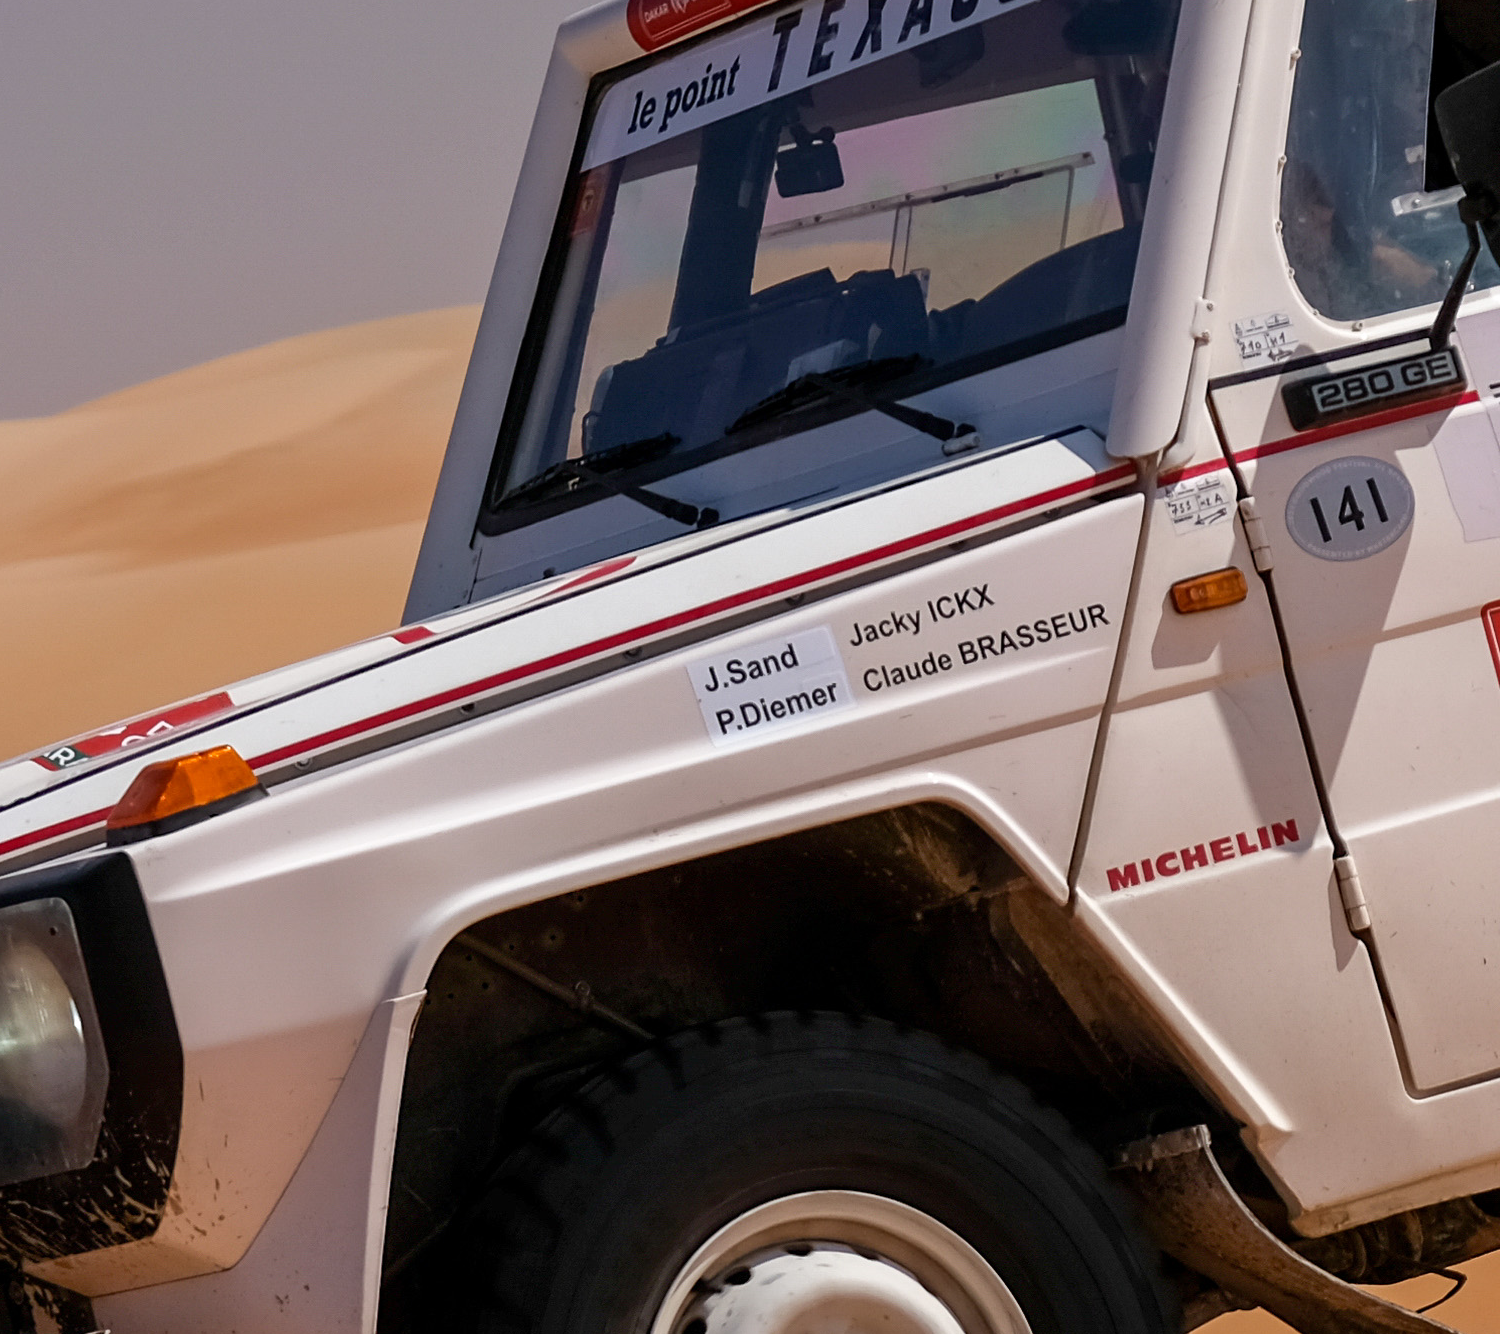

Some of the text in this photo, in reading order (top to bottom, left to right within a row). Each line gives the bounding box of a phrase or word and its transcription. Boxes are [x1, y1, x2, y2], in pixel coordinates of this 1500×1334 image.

[627, 88, 655, 134] le
[658, 55, 741, 133] point
[1317, 355, 1453, 409] 280 GE
[1310, 477, 1389, 543] 141
[850, 583, 995, 648] Jacky ICKX
[863, 603, 1111, 693] Claude BRASSEUR
[1106, 818, 1300, 893] MICHELIN
